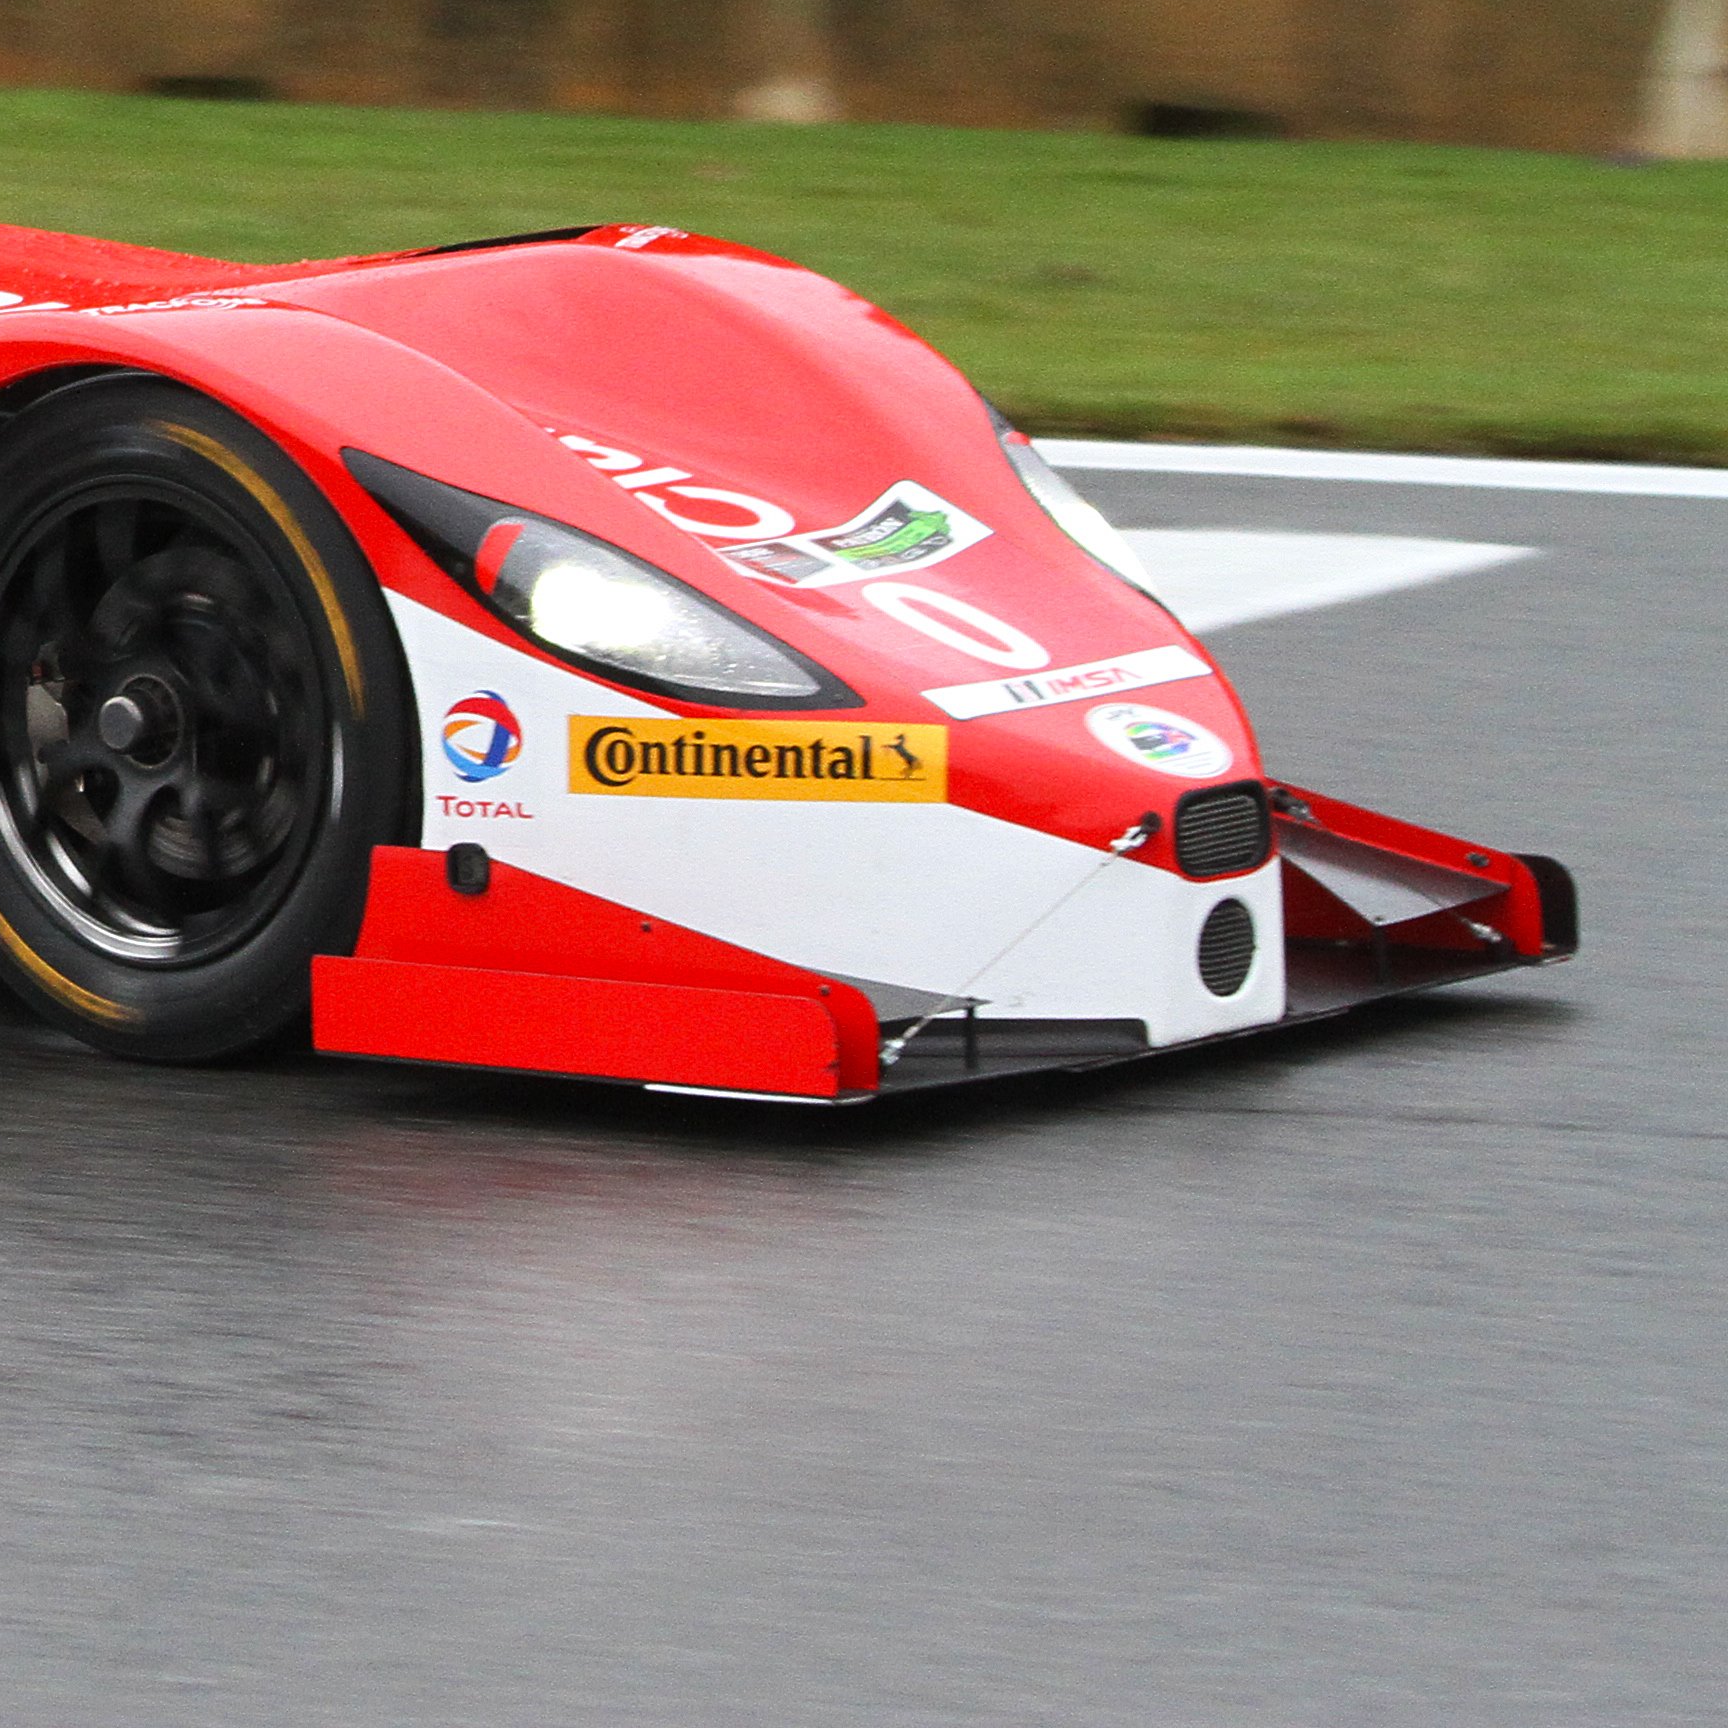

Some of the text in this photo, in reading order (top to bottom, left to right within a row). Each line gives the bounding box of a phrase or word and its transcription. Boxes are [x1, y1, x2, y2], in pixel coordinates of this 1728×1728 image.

[1046, 667, 1142, 696] IMSA
[584, 725, 875, 788] Continental
[435, 796, 534, 820] TOTAL
